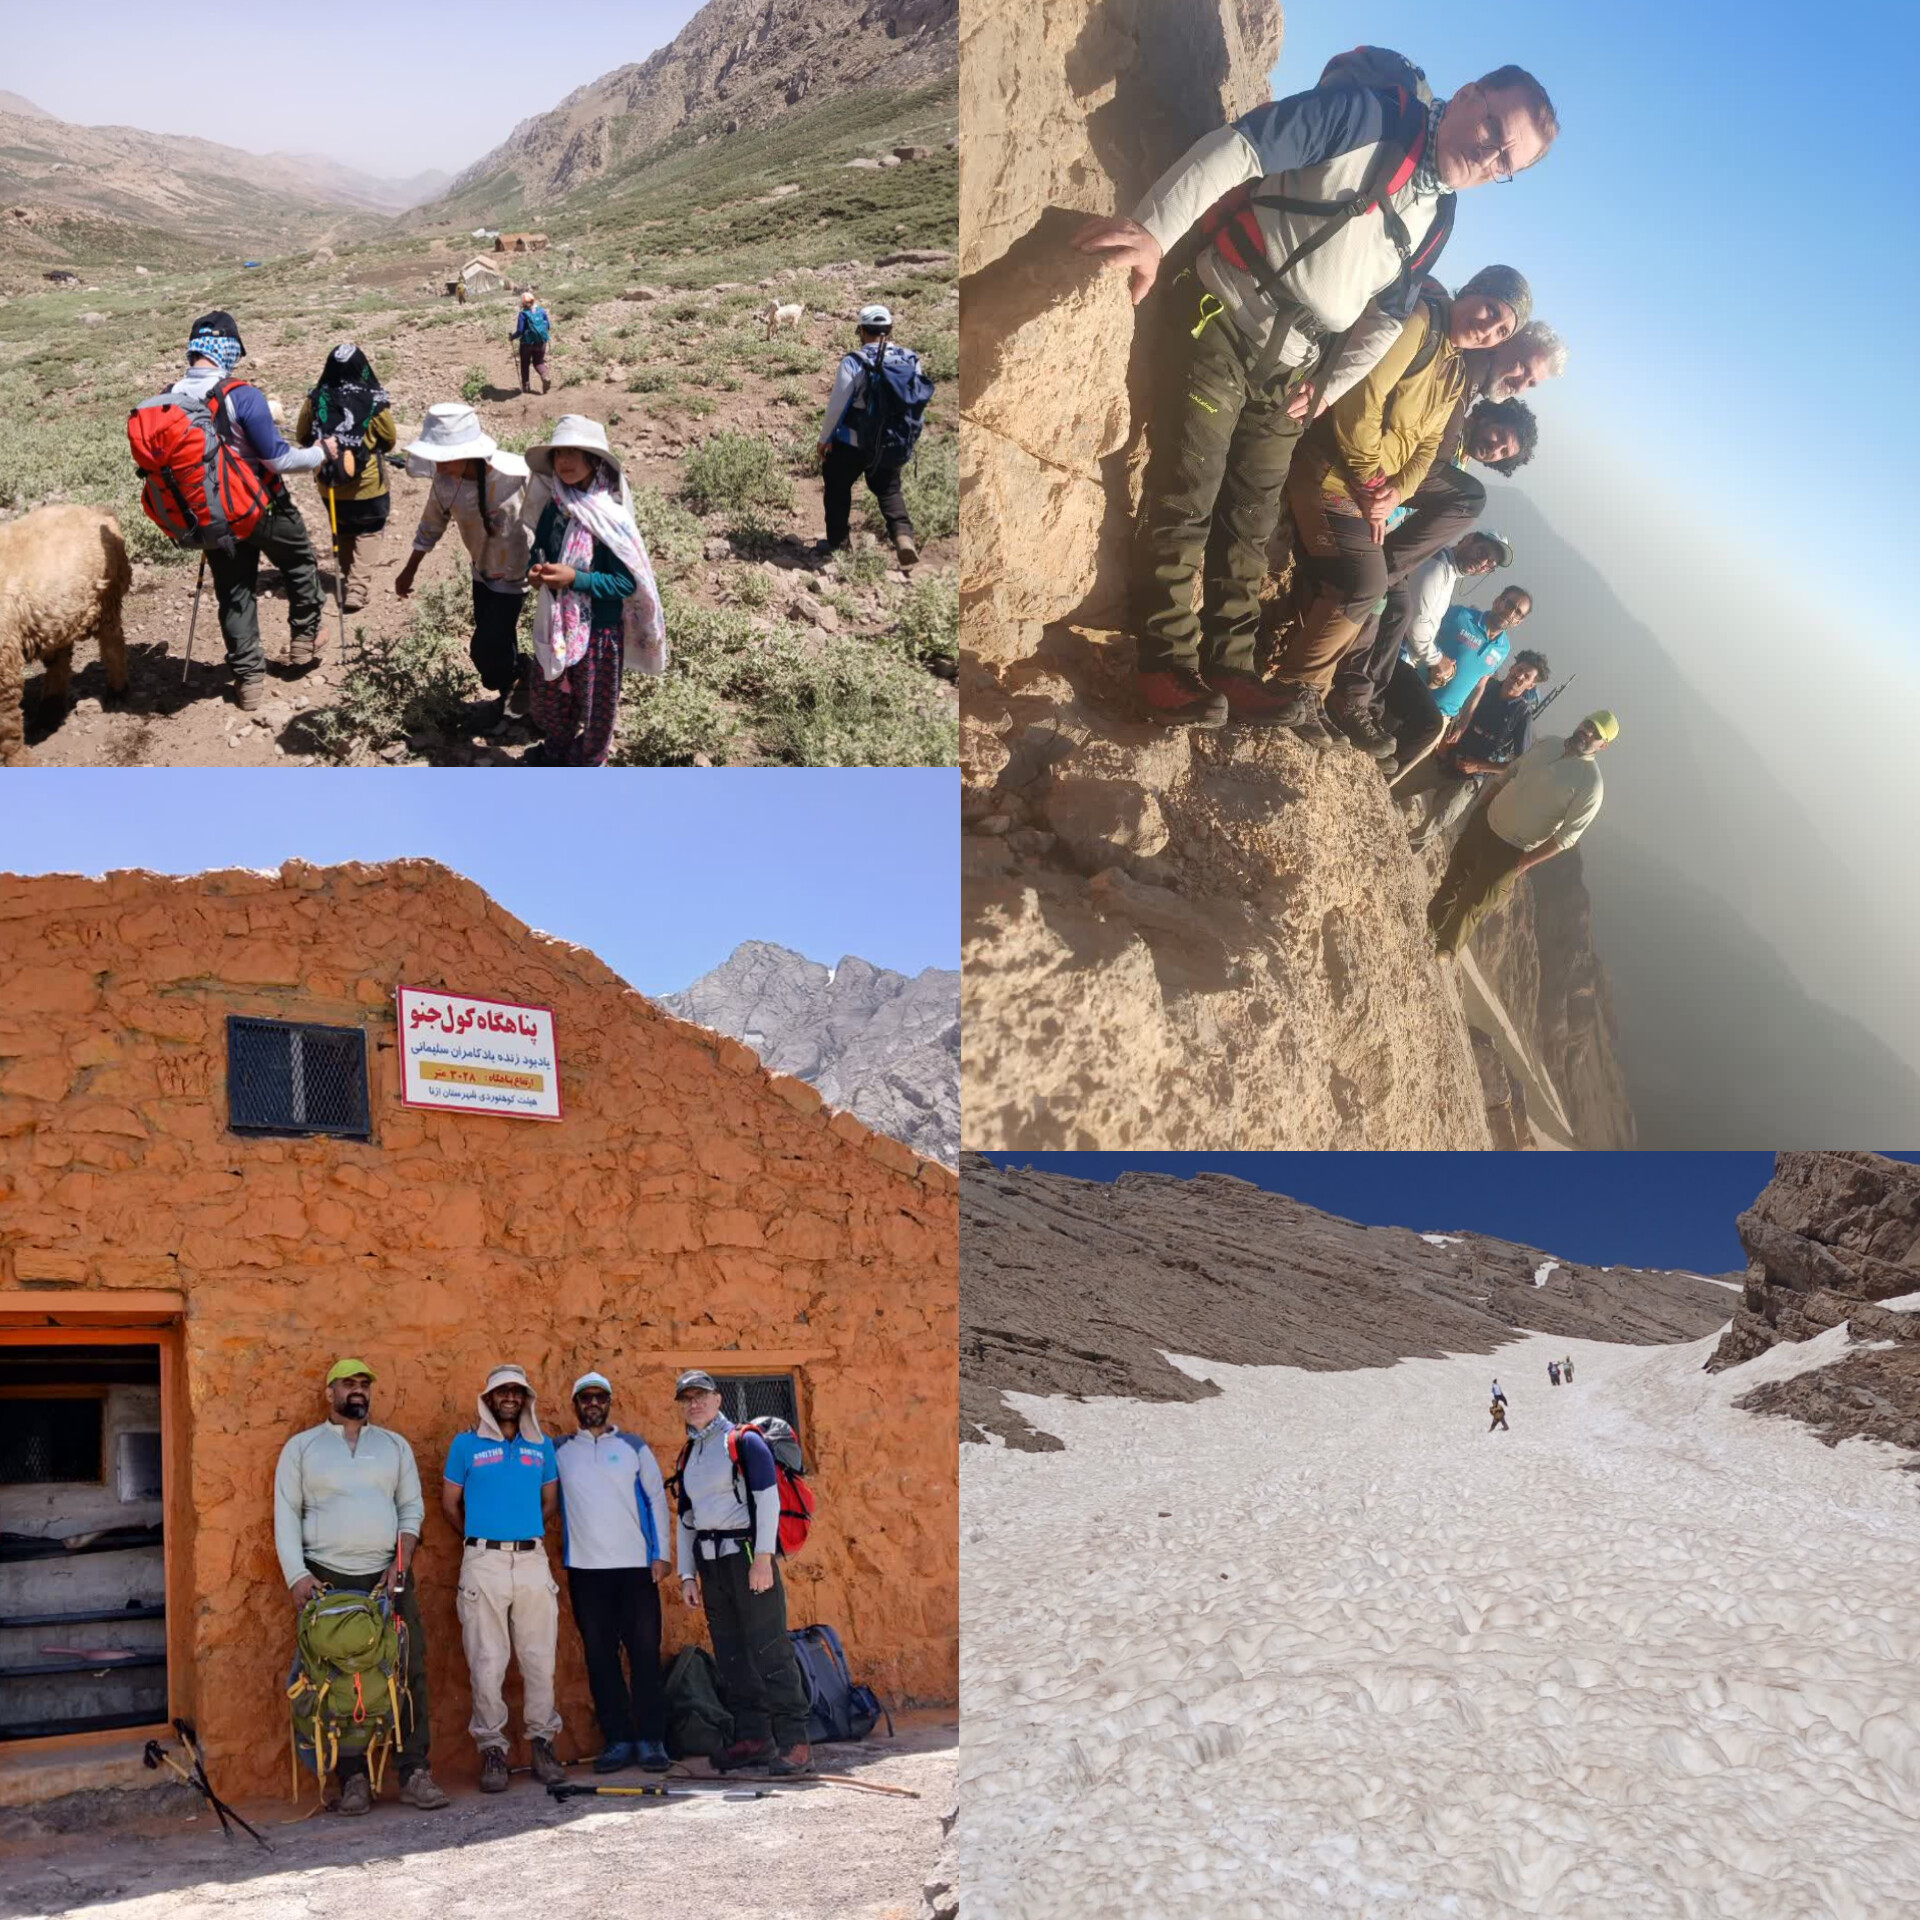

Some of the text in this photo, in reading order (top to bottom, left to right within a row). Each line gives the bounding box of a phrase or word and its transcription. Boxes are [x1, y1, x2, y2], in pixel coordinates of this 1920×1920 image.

[410, 1001, 538, 1045] پناهگاه کول جنو
[411, 1041, 551, 1070] یادبود زنده یاد کامران سلیمانی
[450, 1070, 476, 1083] ۳۰۲۸
